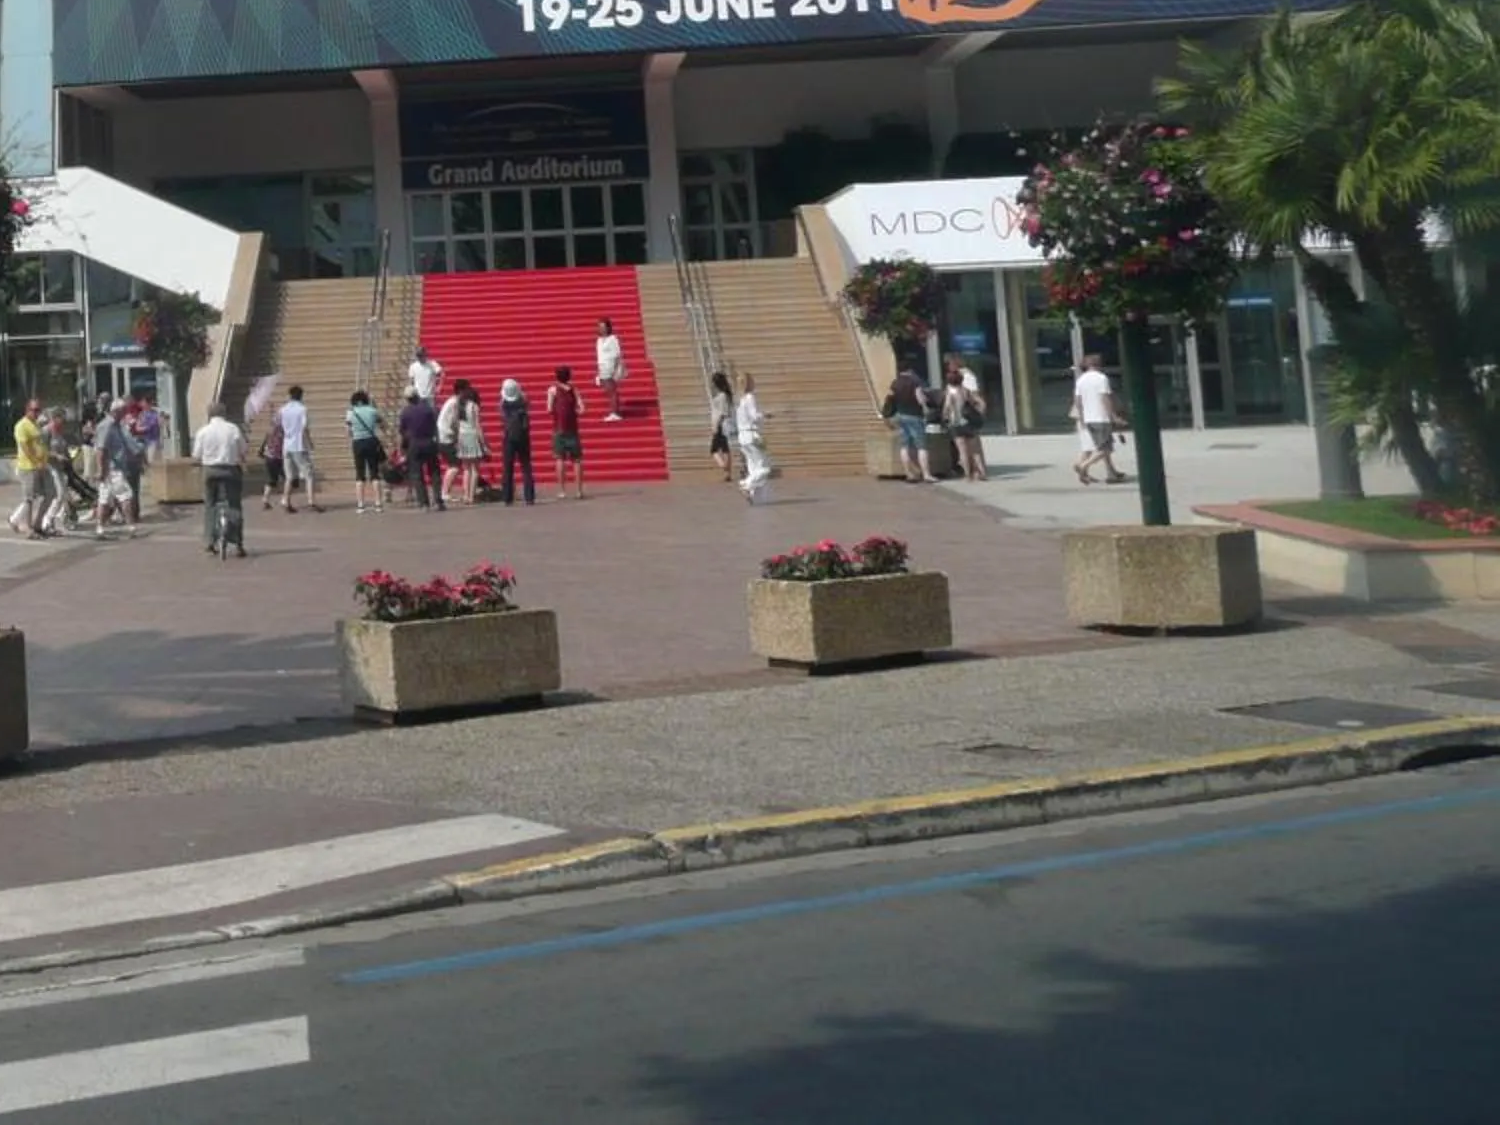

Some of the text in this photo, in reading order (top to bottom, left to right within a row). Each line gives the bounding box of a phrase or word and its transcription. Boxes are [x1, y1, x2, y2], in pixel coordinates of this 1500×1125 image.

[428, 154, 625, 185] Grand Auditorium
[870, 208, 986, 237] MDC
